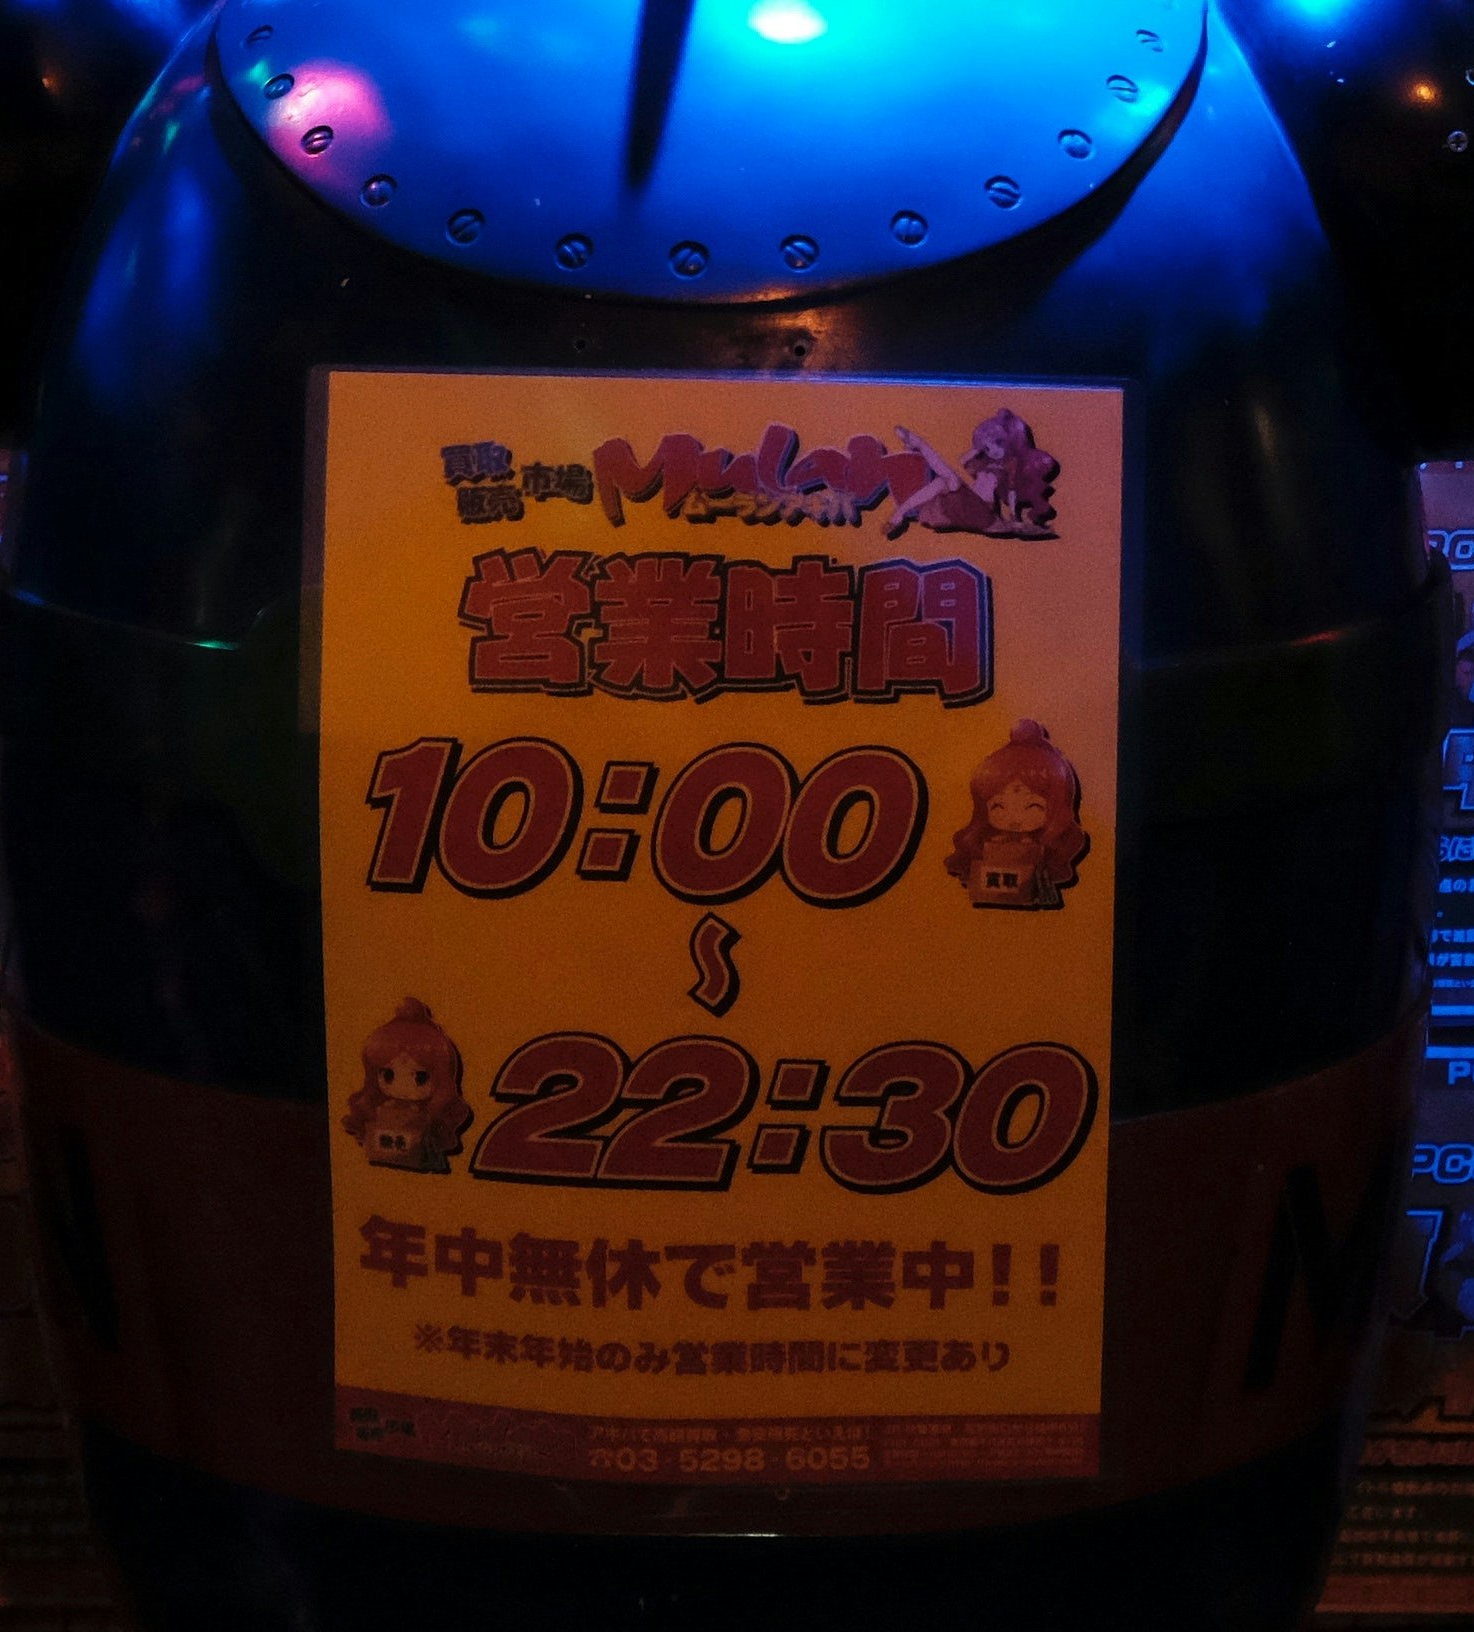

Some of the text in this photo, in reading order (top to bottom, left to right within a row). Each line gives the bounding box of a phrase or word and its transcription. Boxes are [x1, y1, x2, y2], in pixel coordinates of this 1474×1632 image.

[520, 460, 594, 503] 市場
[458, 546, 995, 709] 営業時間
[366, 735, 930, 906] 10:00
[468, 1031, 1099, 1195] 22:30
[359, 1214, 1064, 1311] 年中無休で営業中！！
